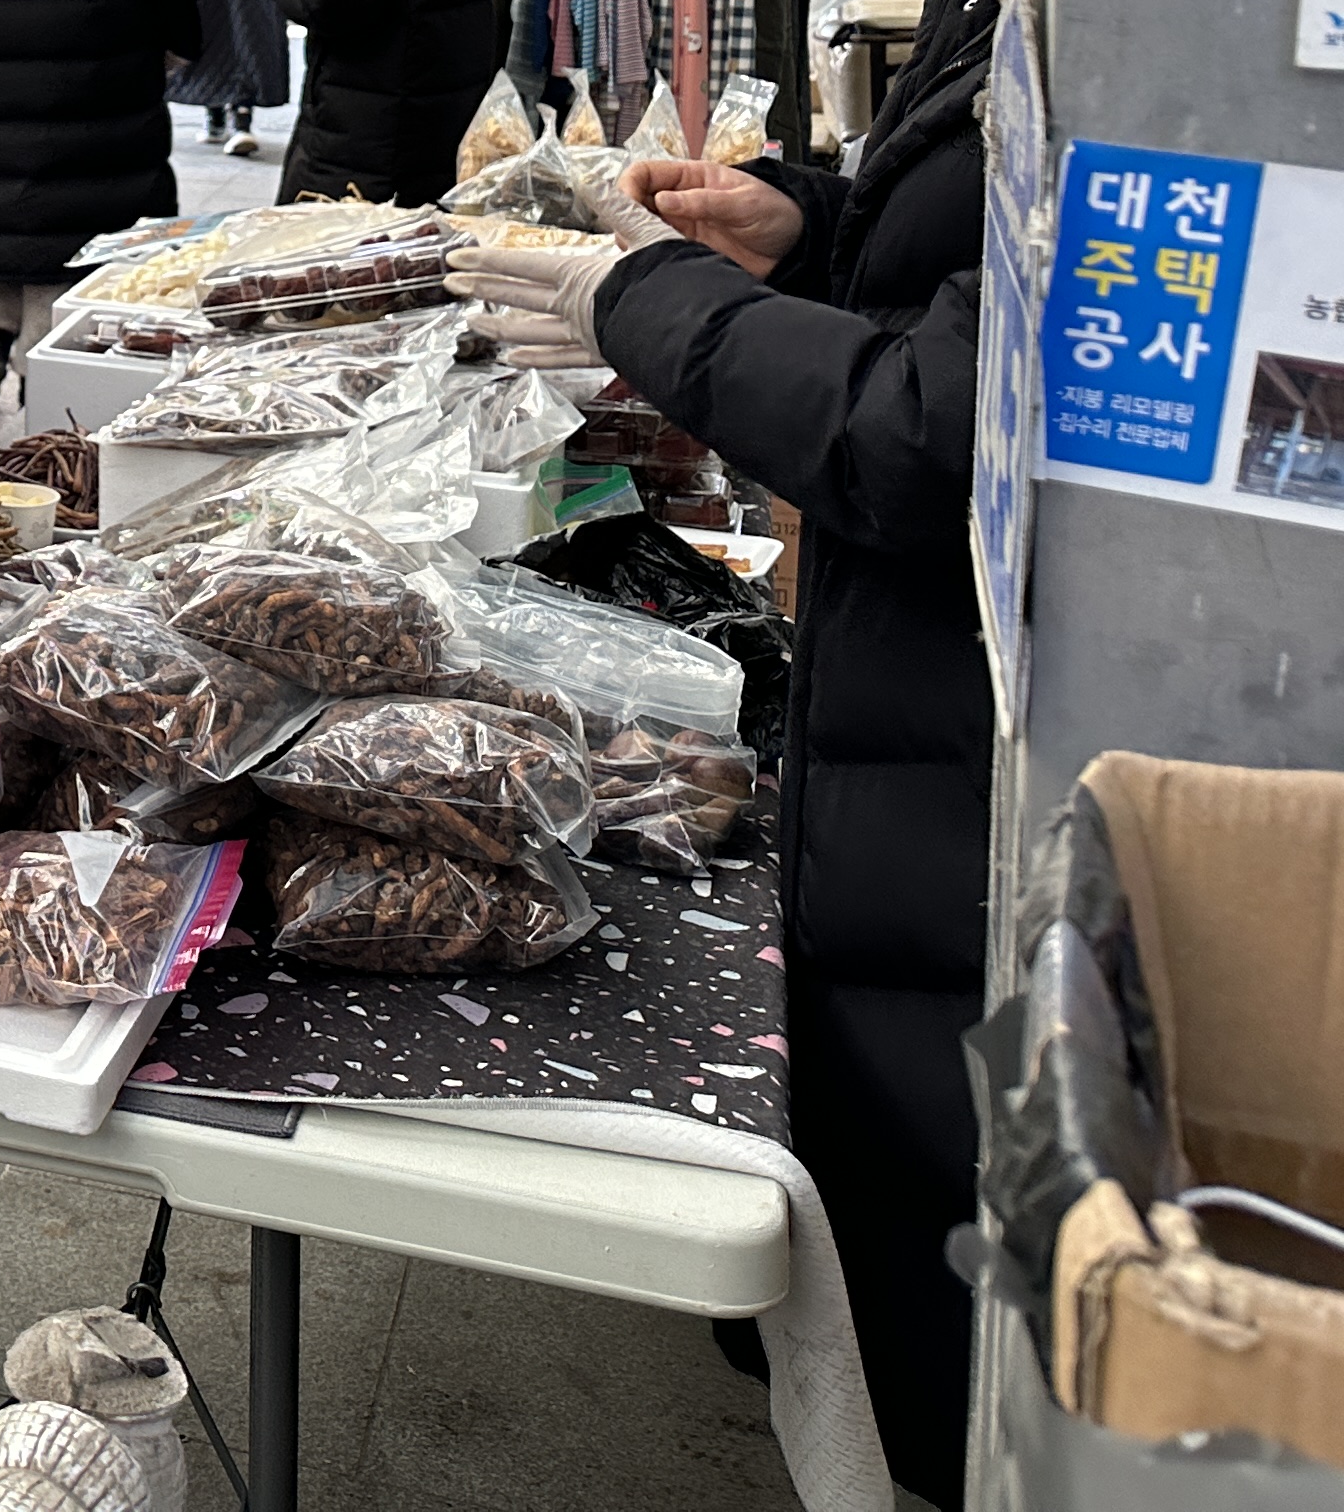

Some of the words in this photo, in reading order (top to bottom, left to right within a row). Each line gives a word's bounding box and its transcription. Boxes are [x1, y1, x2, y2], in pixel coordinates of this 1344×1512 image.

[1085, 170, 1230, 244] 대천
[1073, 238, 1219, 317] 주택
[1063, 305, 1212, 381] 공사
[1109, 392, 1196, 426] 리모델링
[1115, 421, 1191, 454] 전문업체
